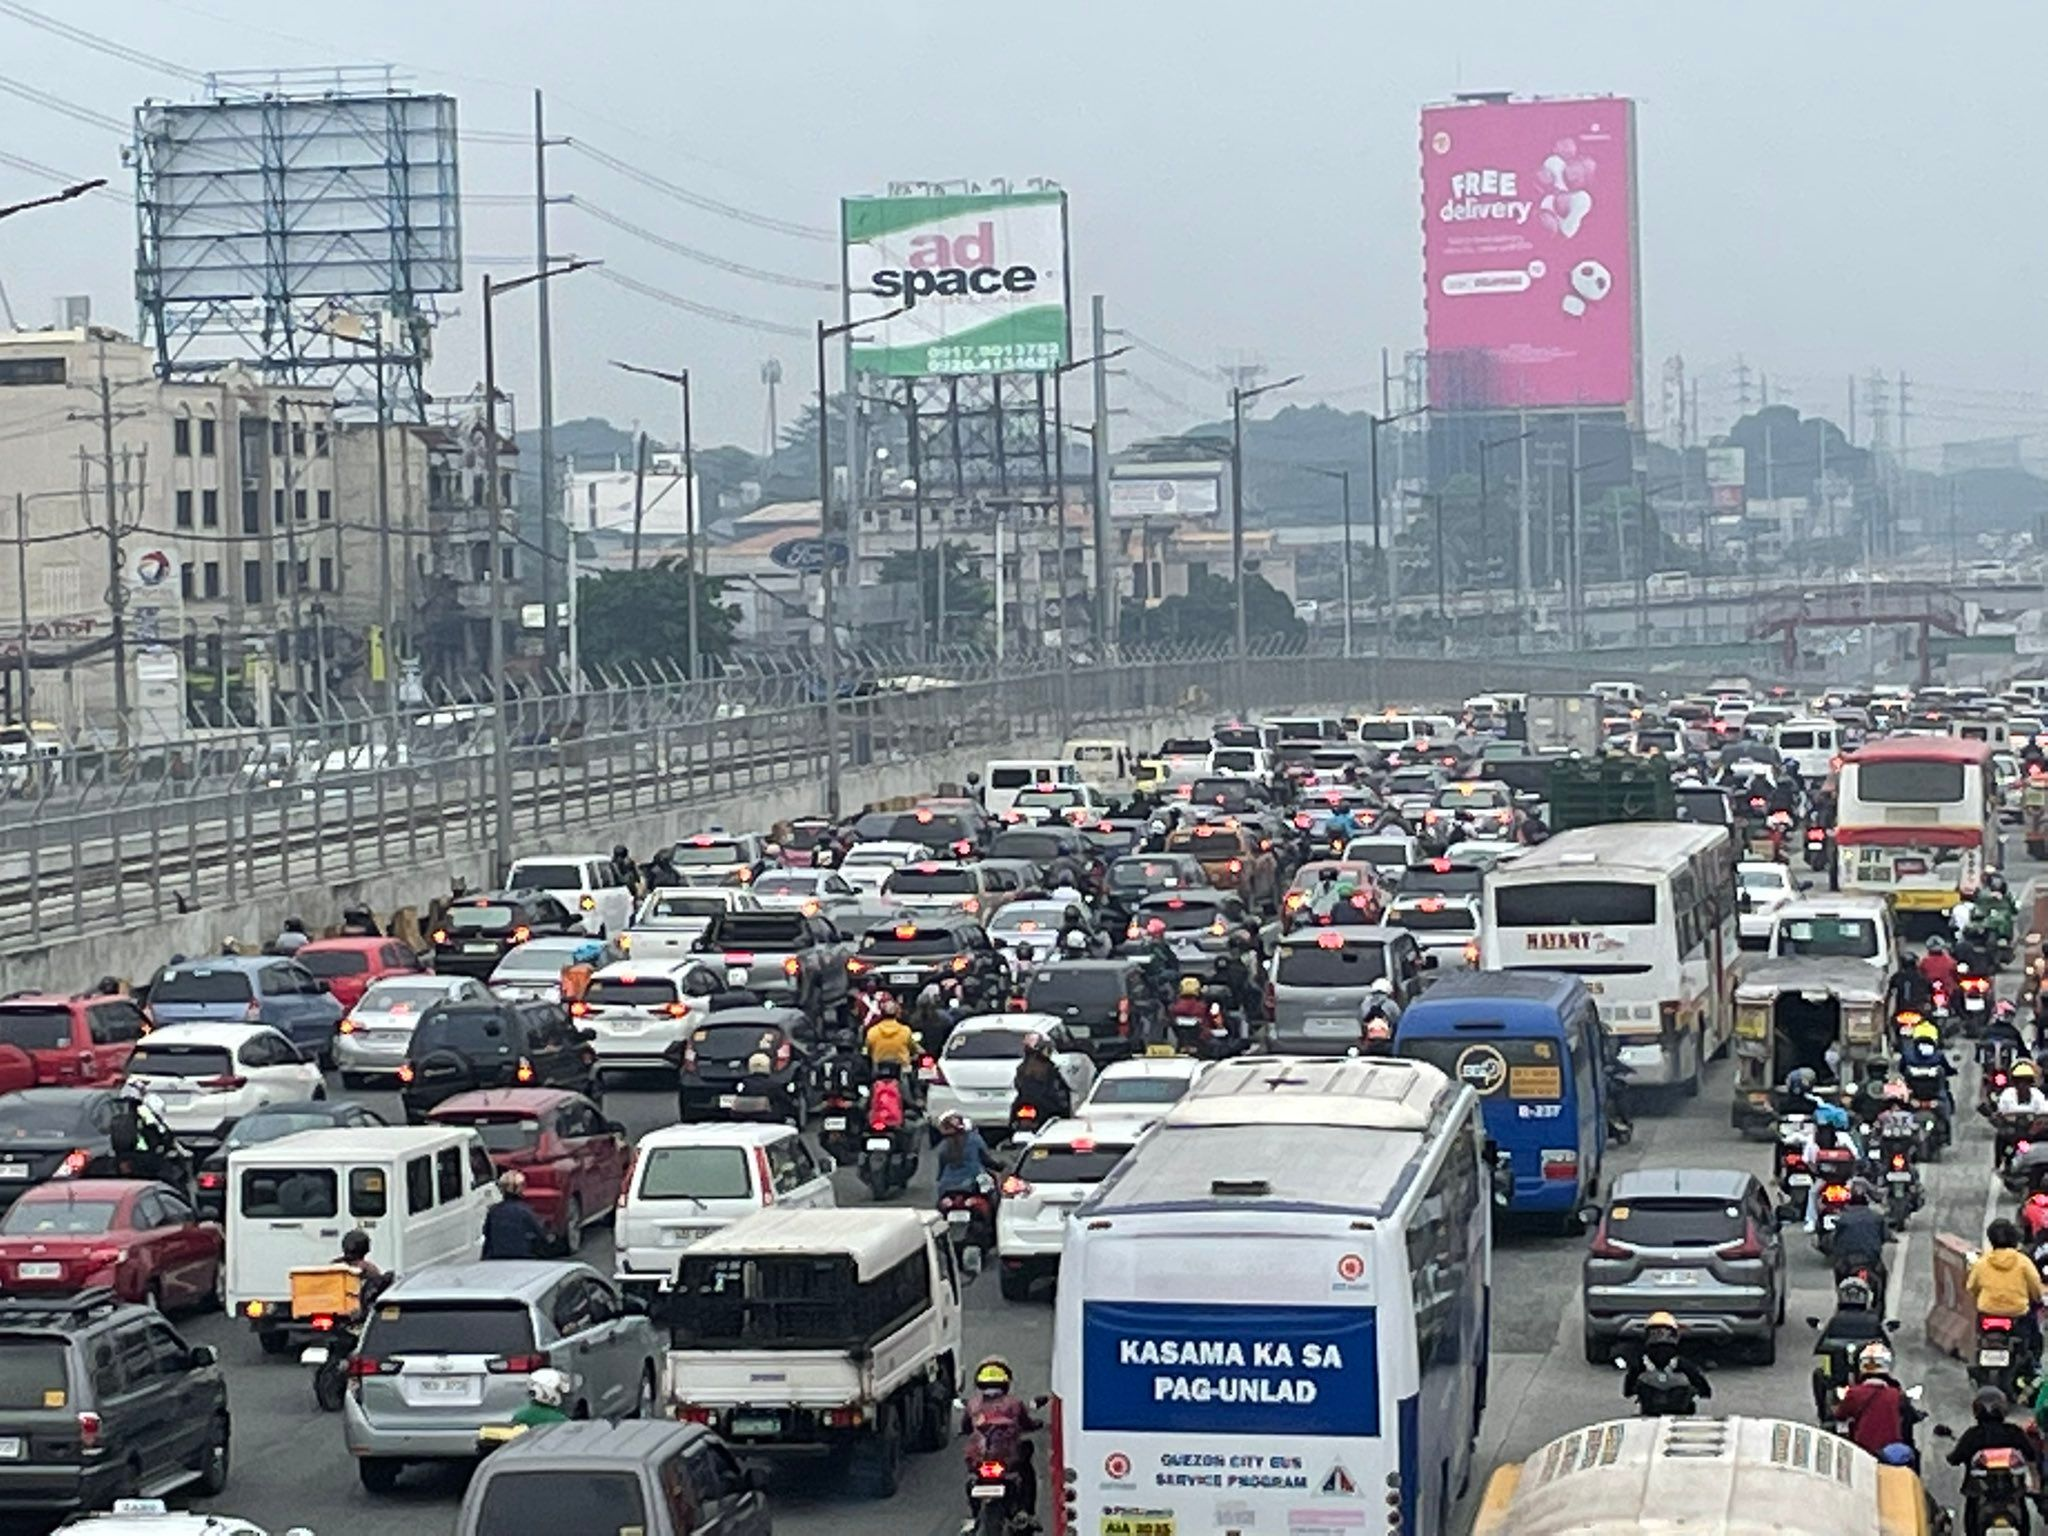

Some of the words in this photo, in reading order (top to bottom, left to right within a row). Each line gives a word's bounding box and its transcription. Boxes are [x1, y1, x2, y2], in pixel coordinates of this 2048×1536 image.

[1451, 169, 1518, 199] FREE
[1440, 196, 1533, 225] delivery
[908, 221, 995, 269] ad
[872, 265, 1037, 310] space
[1119, 1339, 1246, 1367] KASAMA
[1253, 1341, 1294, 1368] KA
[1301, 1343, 1343, 1369] SA
[1153, 1375, 1318, 1404] PAG-UNLAD
[1160, 1453, 1226, 1467] QUEZON
[1229, 1455, 1264, 1468] CITY
[1269, 1456, 1303, 1469] BUS
[1155, 1473, 1223, 1487] SERVICE
[1227, 1475, 1308, 1489] PROGRAM
